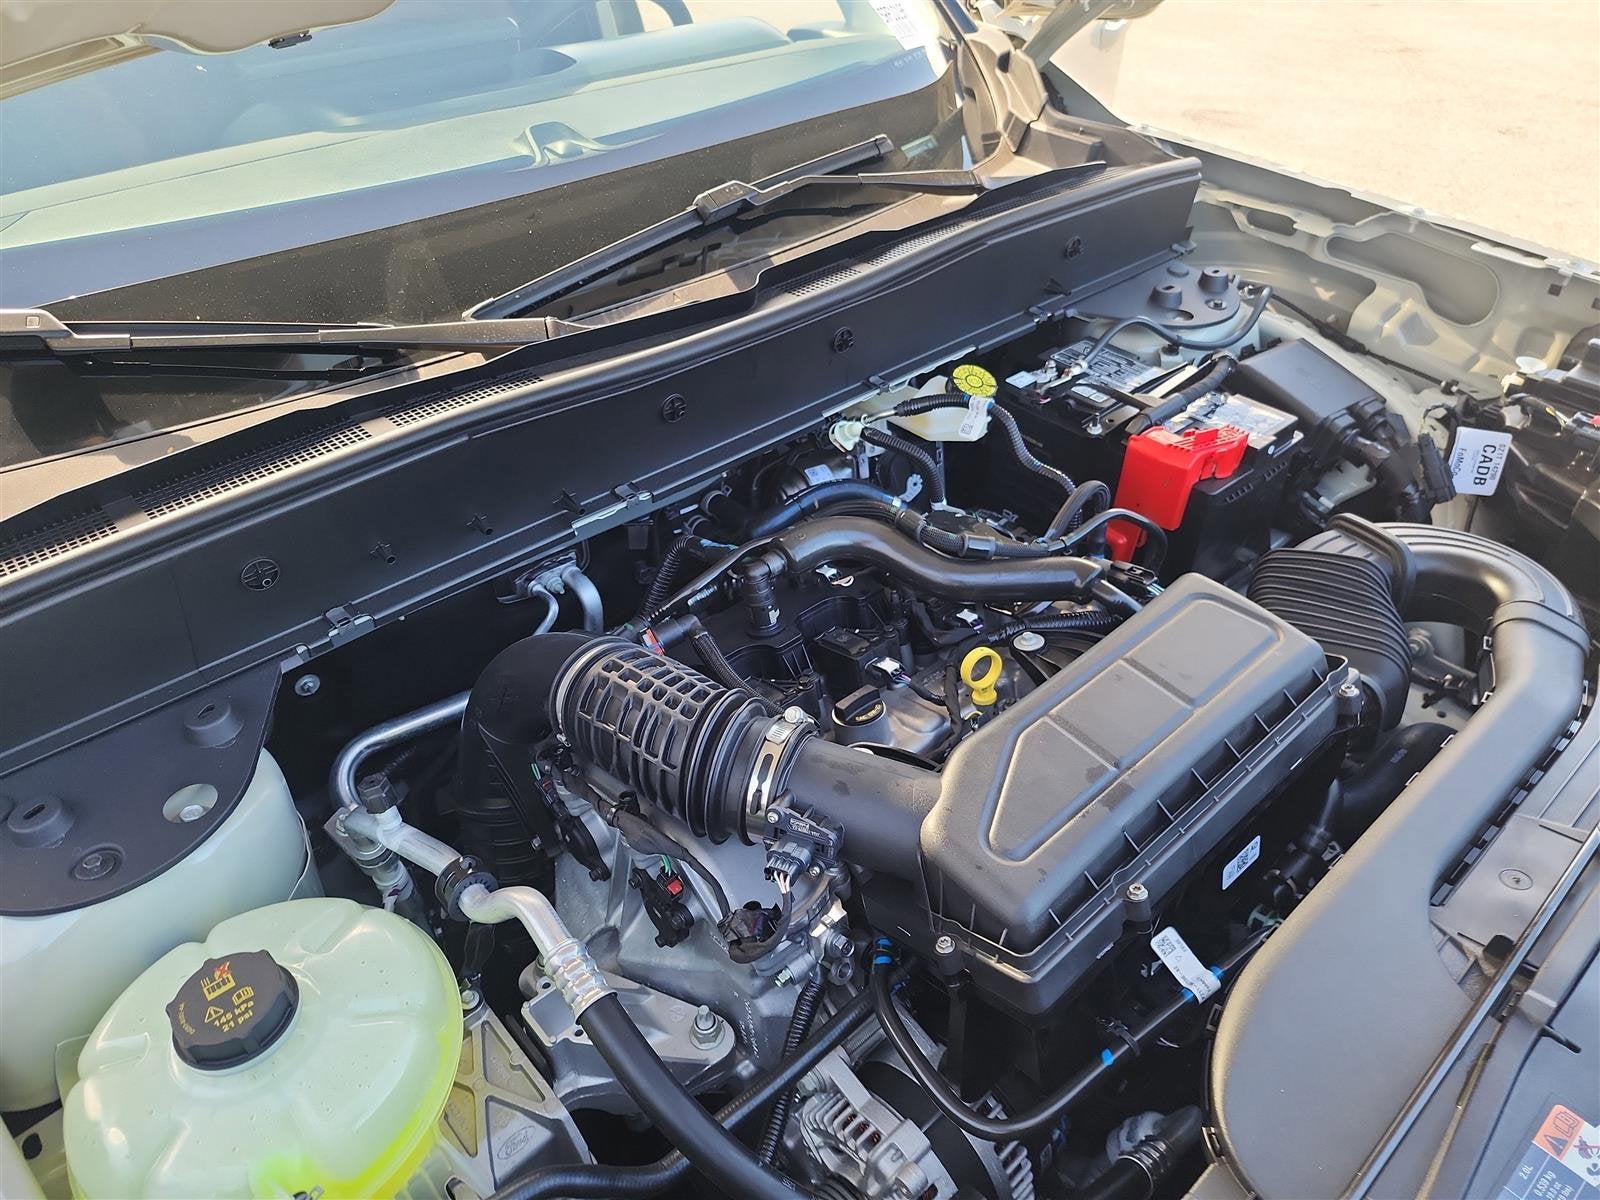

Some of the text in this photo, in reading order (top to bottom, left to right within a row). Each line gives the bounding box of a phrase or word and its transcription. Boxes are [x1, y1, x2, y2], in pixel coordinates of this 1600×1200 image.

[1473, 444, 1497, 485] CADB
[213, 1011, 233, 1027] 145
[234, 1000, 254, 1015] kPa
[222, 1009, 253, 1032] 21 psi
[1519, 1165, 1534, 1180] 2.0L
